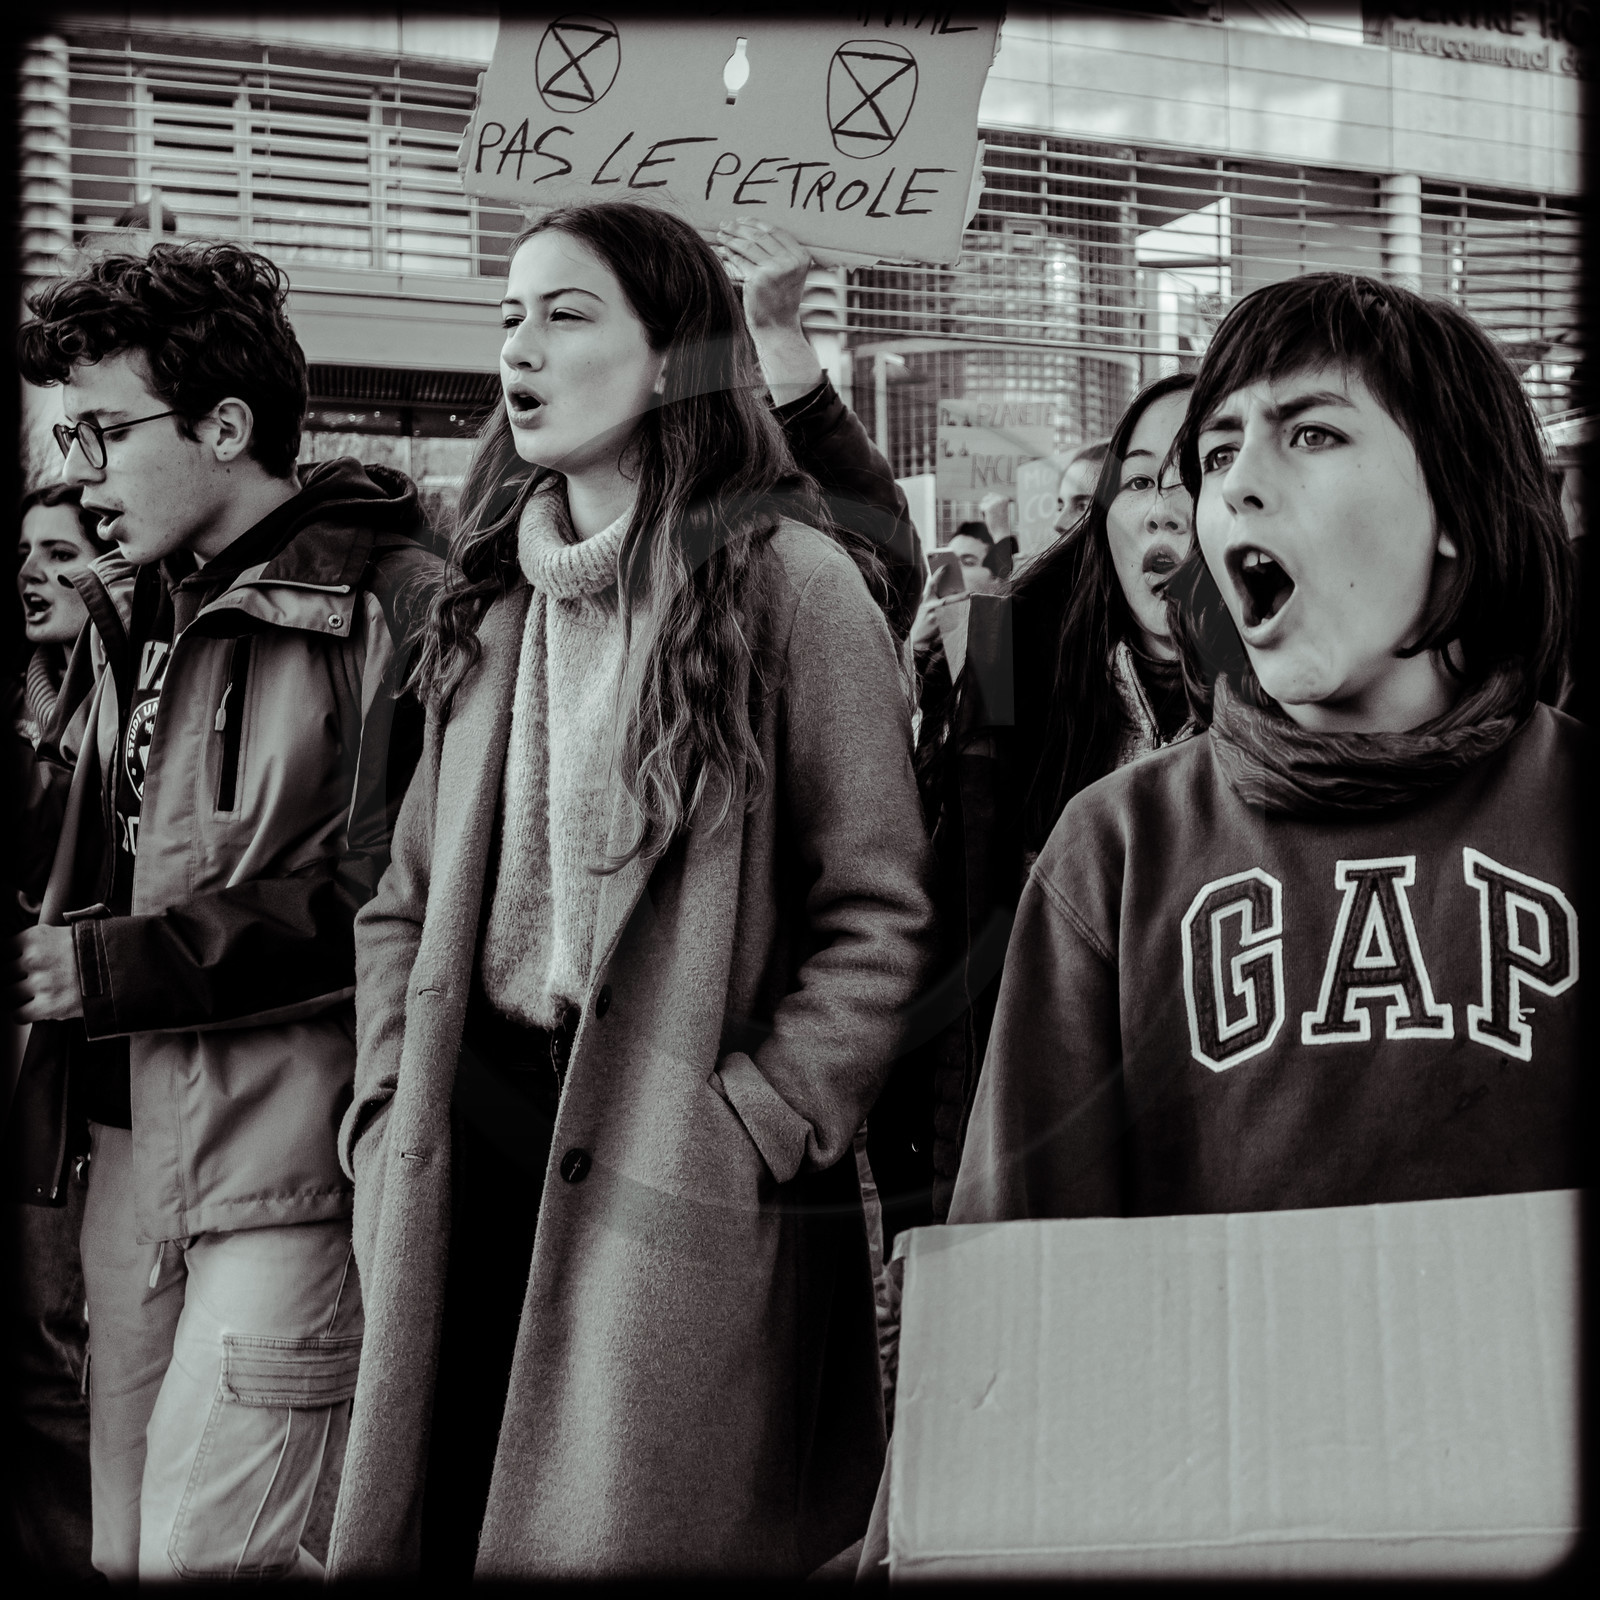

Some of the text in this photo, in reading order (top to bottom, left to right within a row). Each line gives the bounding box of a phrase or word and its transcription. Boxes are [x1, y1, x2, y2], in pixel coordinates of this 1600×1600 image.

[474, 118, 958, 218] PAS LE PETROLE
[1181, 847, 1580, 1073] GAP
